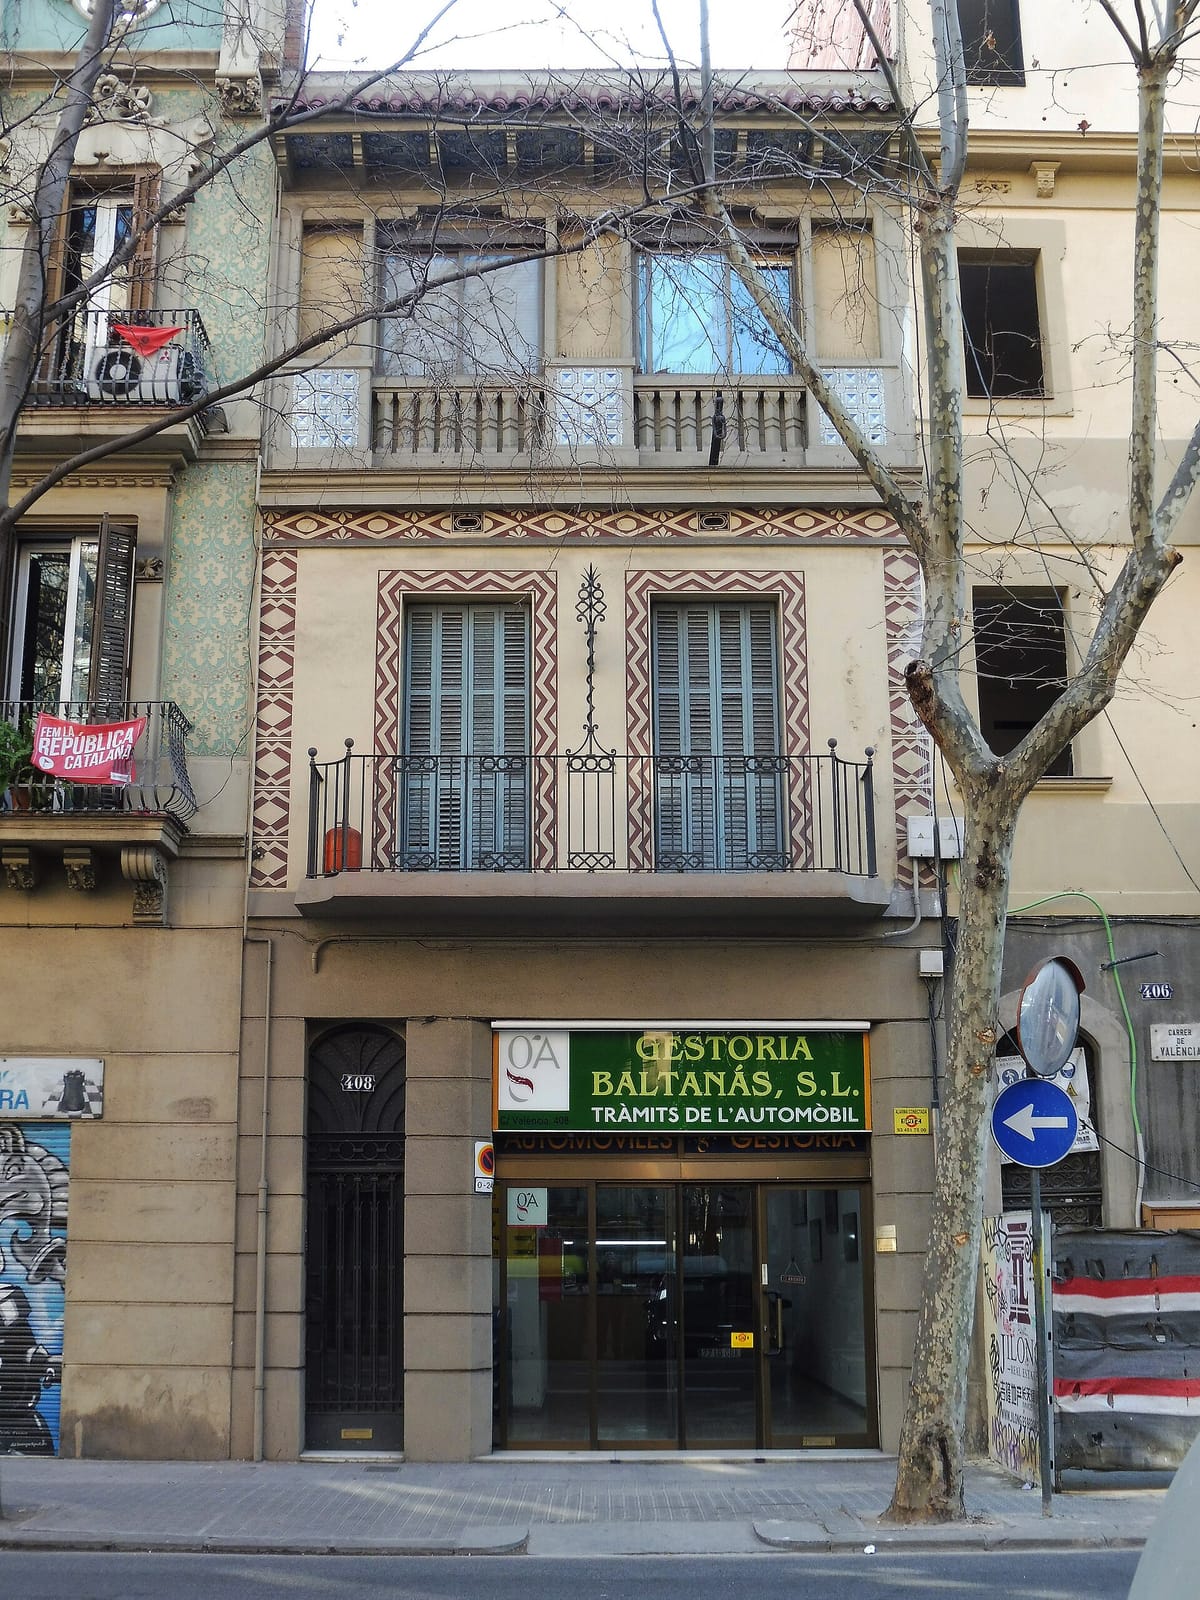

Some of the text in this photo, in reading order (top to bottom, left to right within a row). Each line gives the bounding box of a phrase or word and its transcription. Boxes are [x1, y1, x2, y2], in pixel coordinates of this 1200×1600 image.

[41, 725, 75, 738] FEM LA
[38, 727, 134, 757] REPÚBLICA
[64, 744, 132, 770] CATALANA
[1142, 984, 1169, 998] 406
[1168, 1028, 1192, 1036] CARRER
[1176, 1037, 1185, 1045] DE
[635, 1034, 814, 1061] GESTORIA
[344, 1075, 372, 1090] 408
[591, 1063, 860, 1099] BALTANÁS, S.L.
[591, 1102, 680, 1123] TRÀMITS
[685, 1106, 712, 1123] DE
